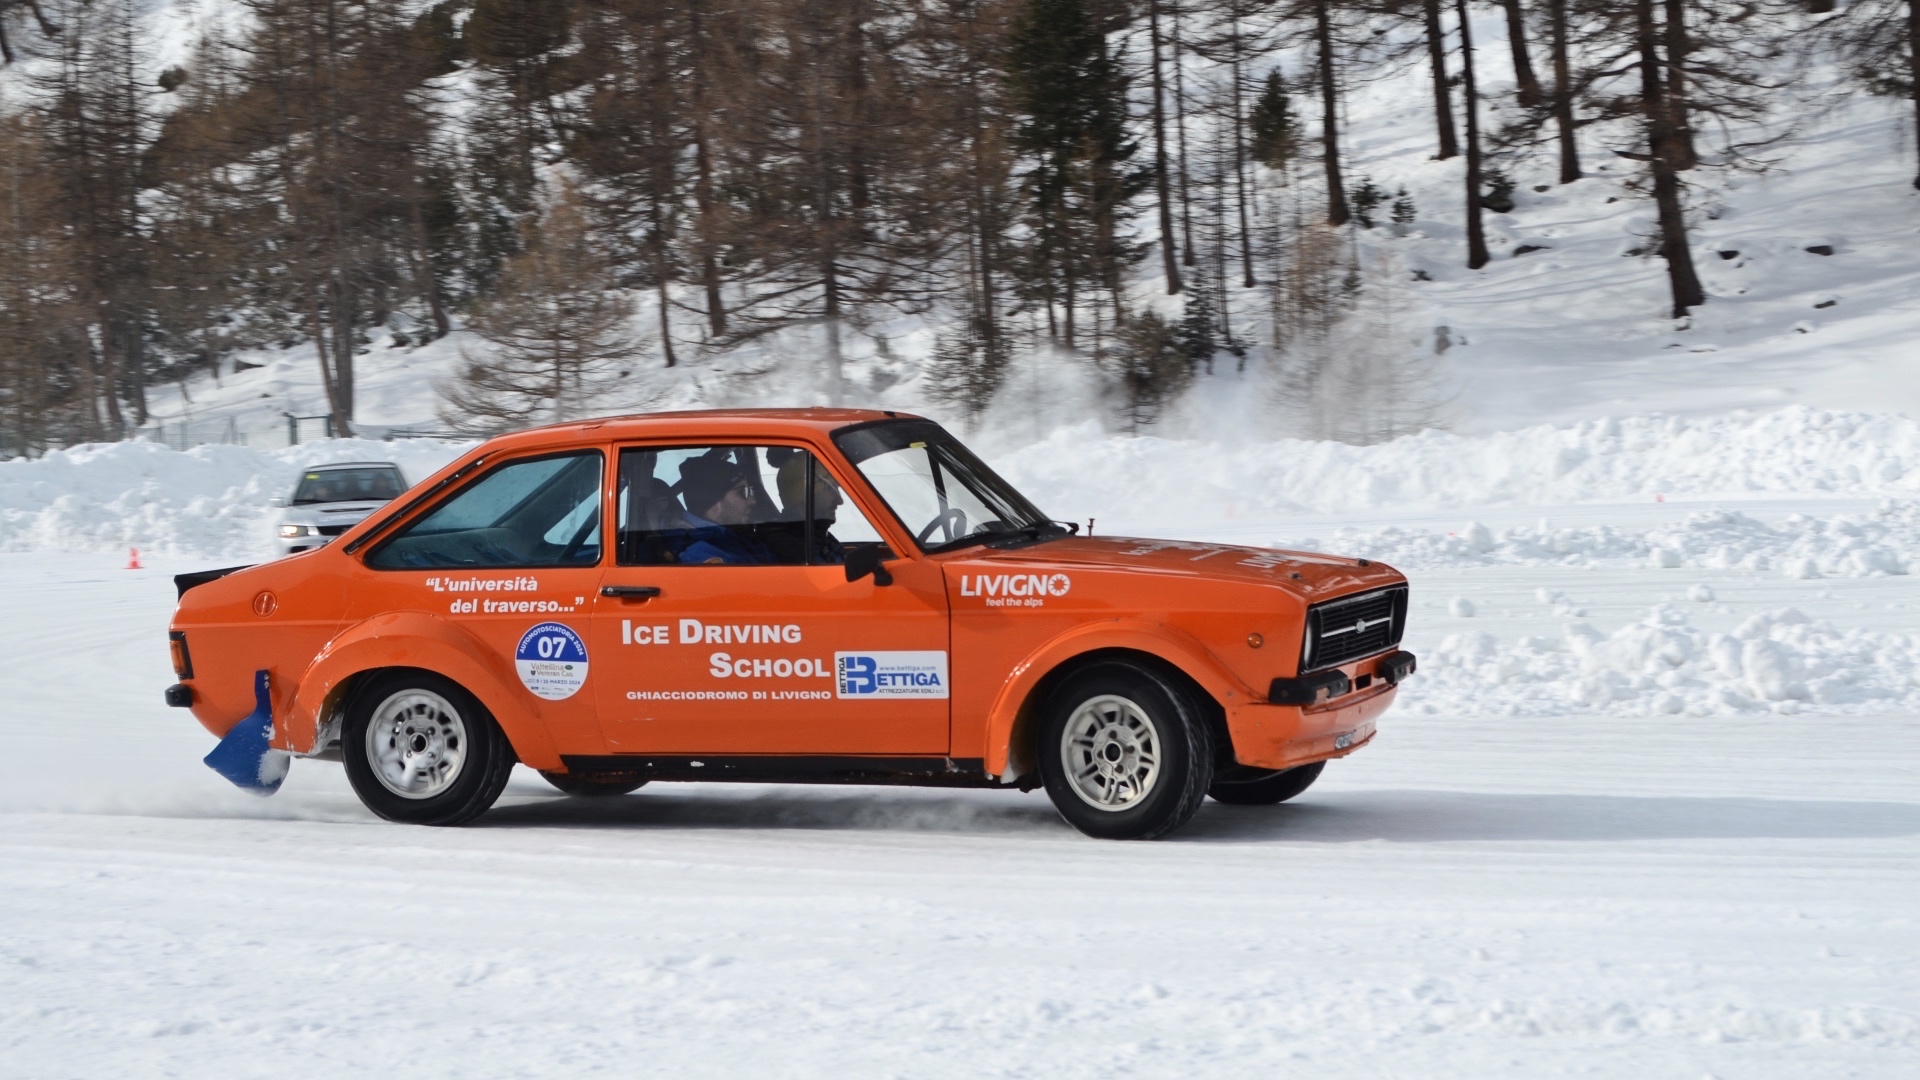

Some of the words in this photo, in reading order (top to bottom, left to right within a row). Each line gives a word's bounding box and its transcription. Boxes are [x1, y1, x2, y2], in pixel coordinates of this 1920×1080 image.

[961, 574, 1070, 596] LIVIGNO
[450, 599, 478, 613] del
[986, 598, 1005, 606] feel
[1006, 598, 1022, 606] the
[1024, 598, 1043, 608] alps
[520, 625, 576, 654] AUTOMOTOSCIATORIA
[573, 640, 584, 656] 2024
[538, 636, 567, 658] 07
[838, 657, 847, 694] BETTIGA
[626, 691, 748, 700] GHIACCIODROMO
[752, 691, 767, 700] DI
[771, 691, 832, 700] LIVIGNO
